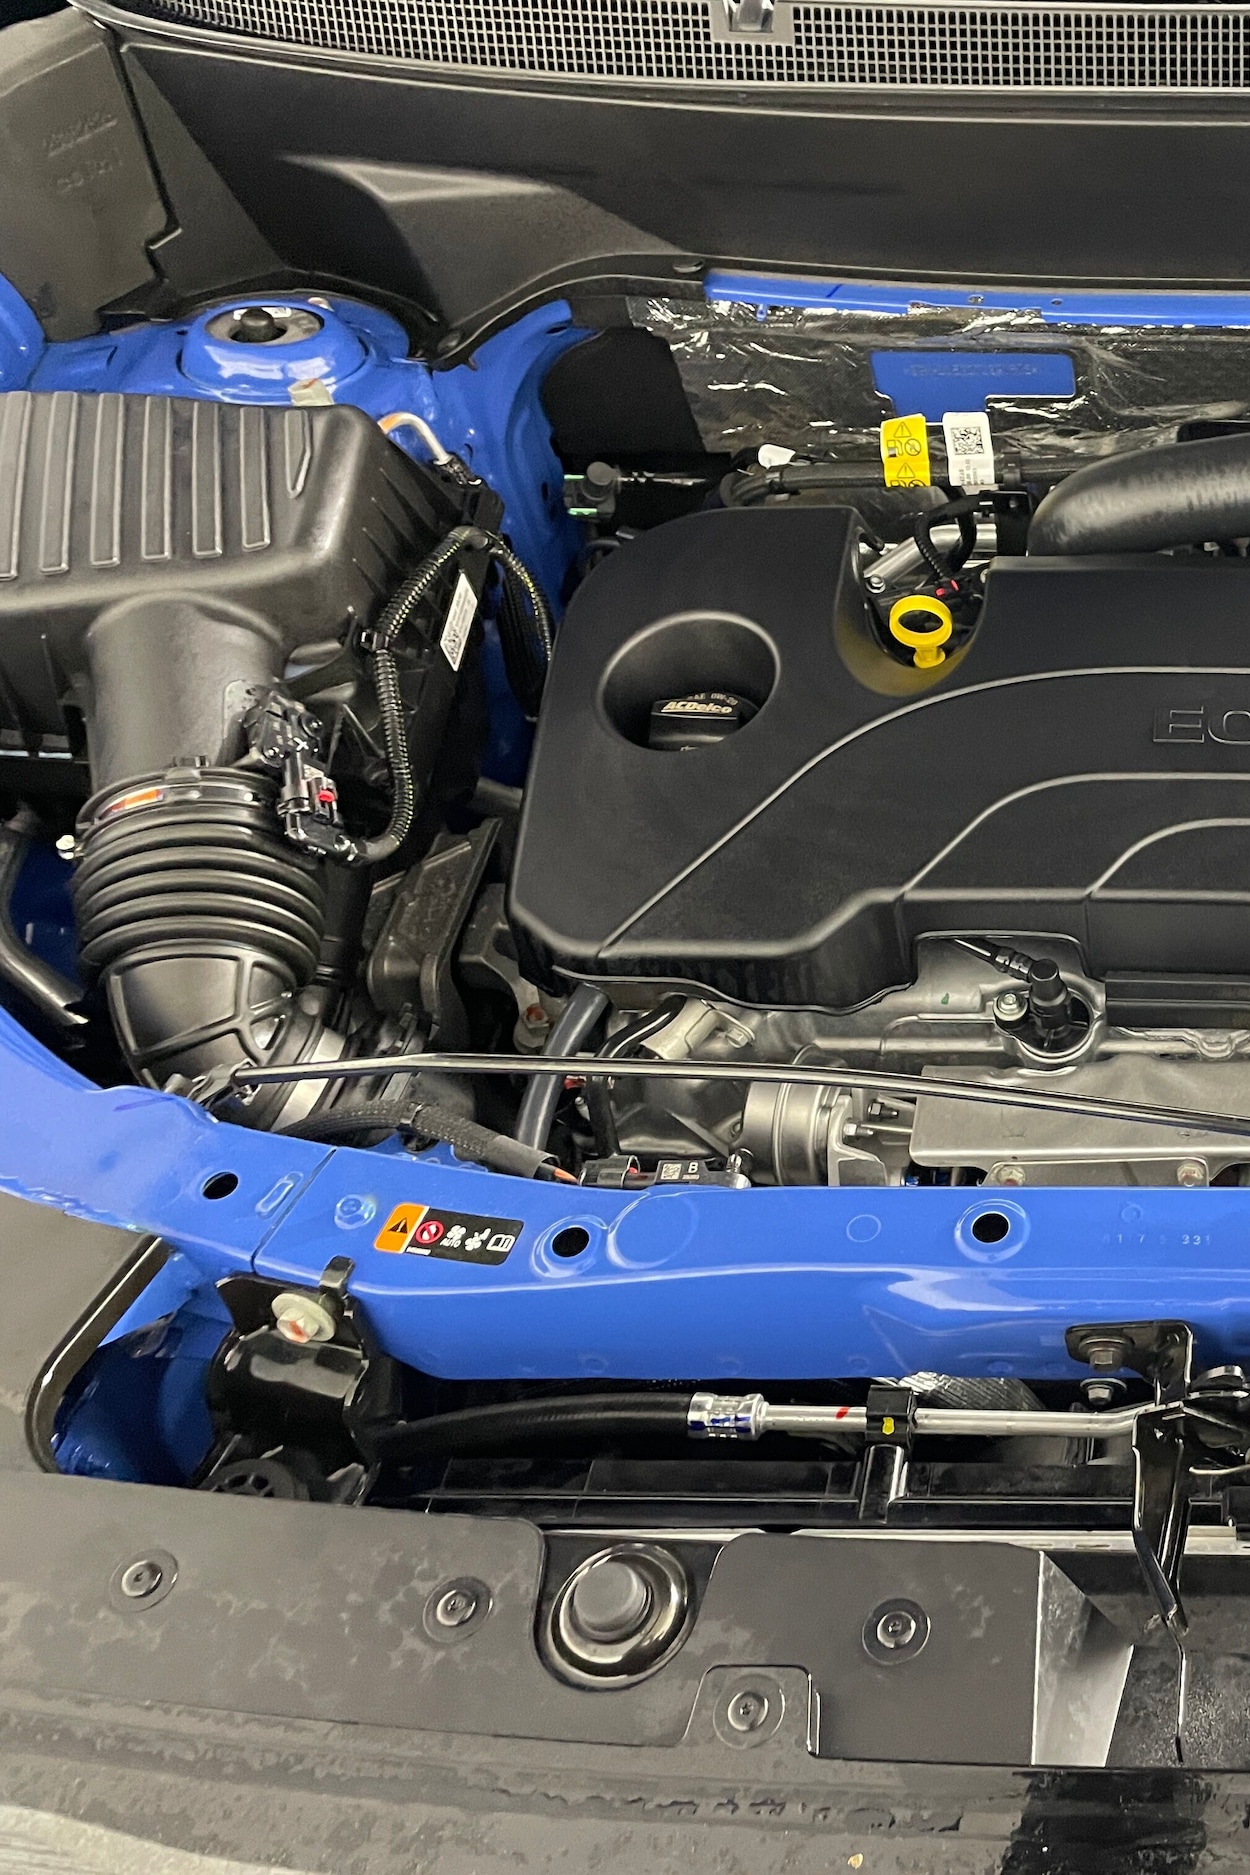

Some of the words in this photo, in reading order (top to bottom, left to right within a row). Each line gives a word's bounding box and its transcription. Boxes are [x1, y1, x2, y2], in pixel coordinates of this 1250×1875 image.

[661, 701, 733, 714] ACDelco
[688, 1162, 699, 1174] B
[440, 1238, 462, 1249] AUTO
